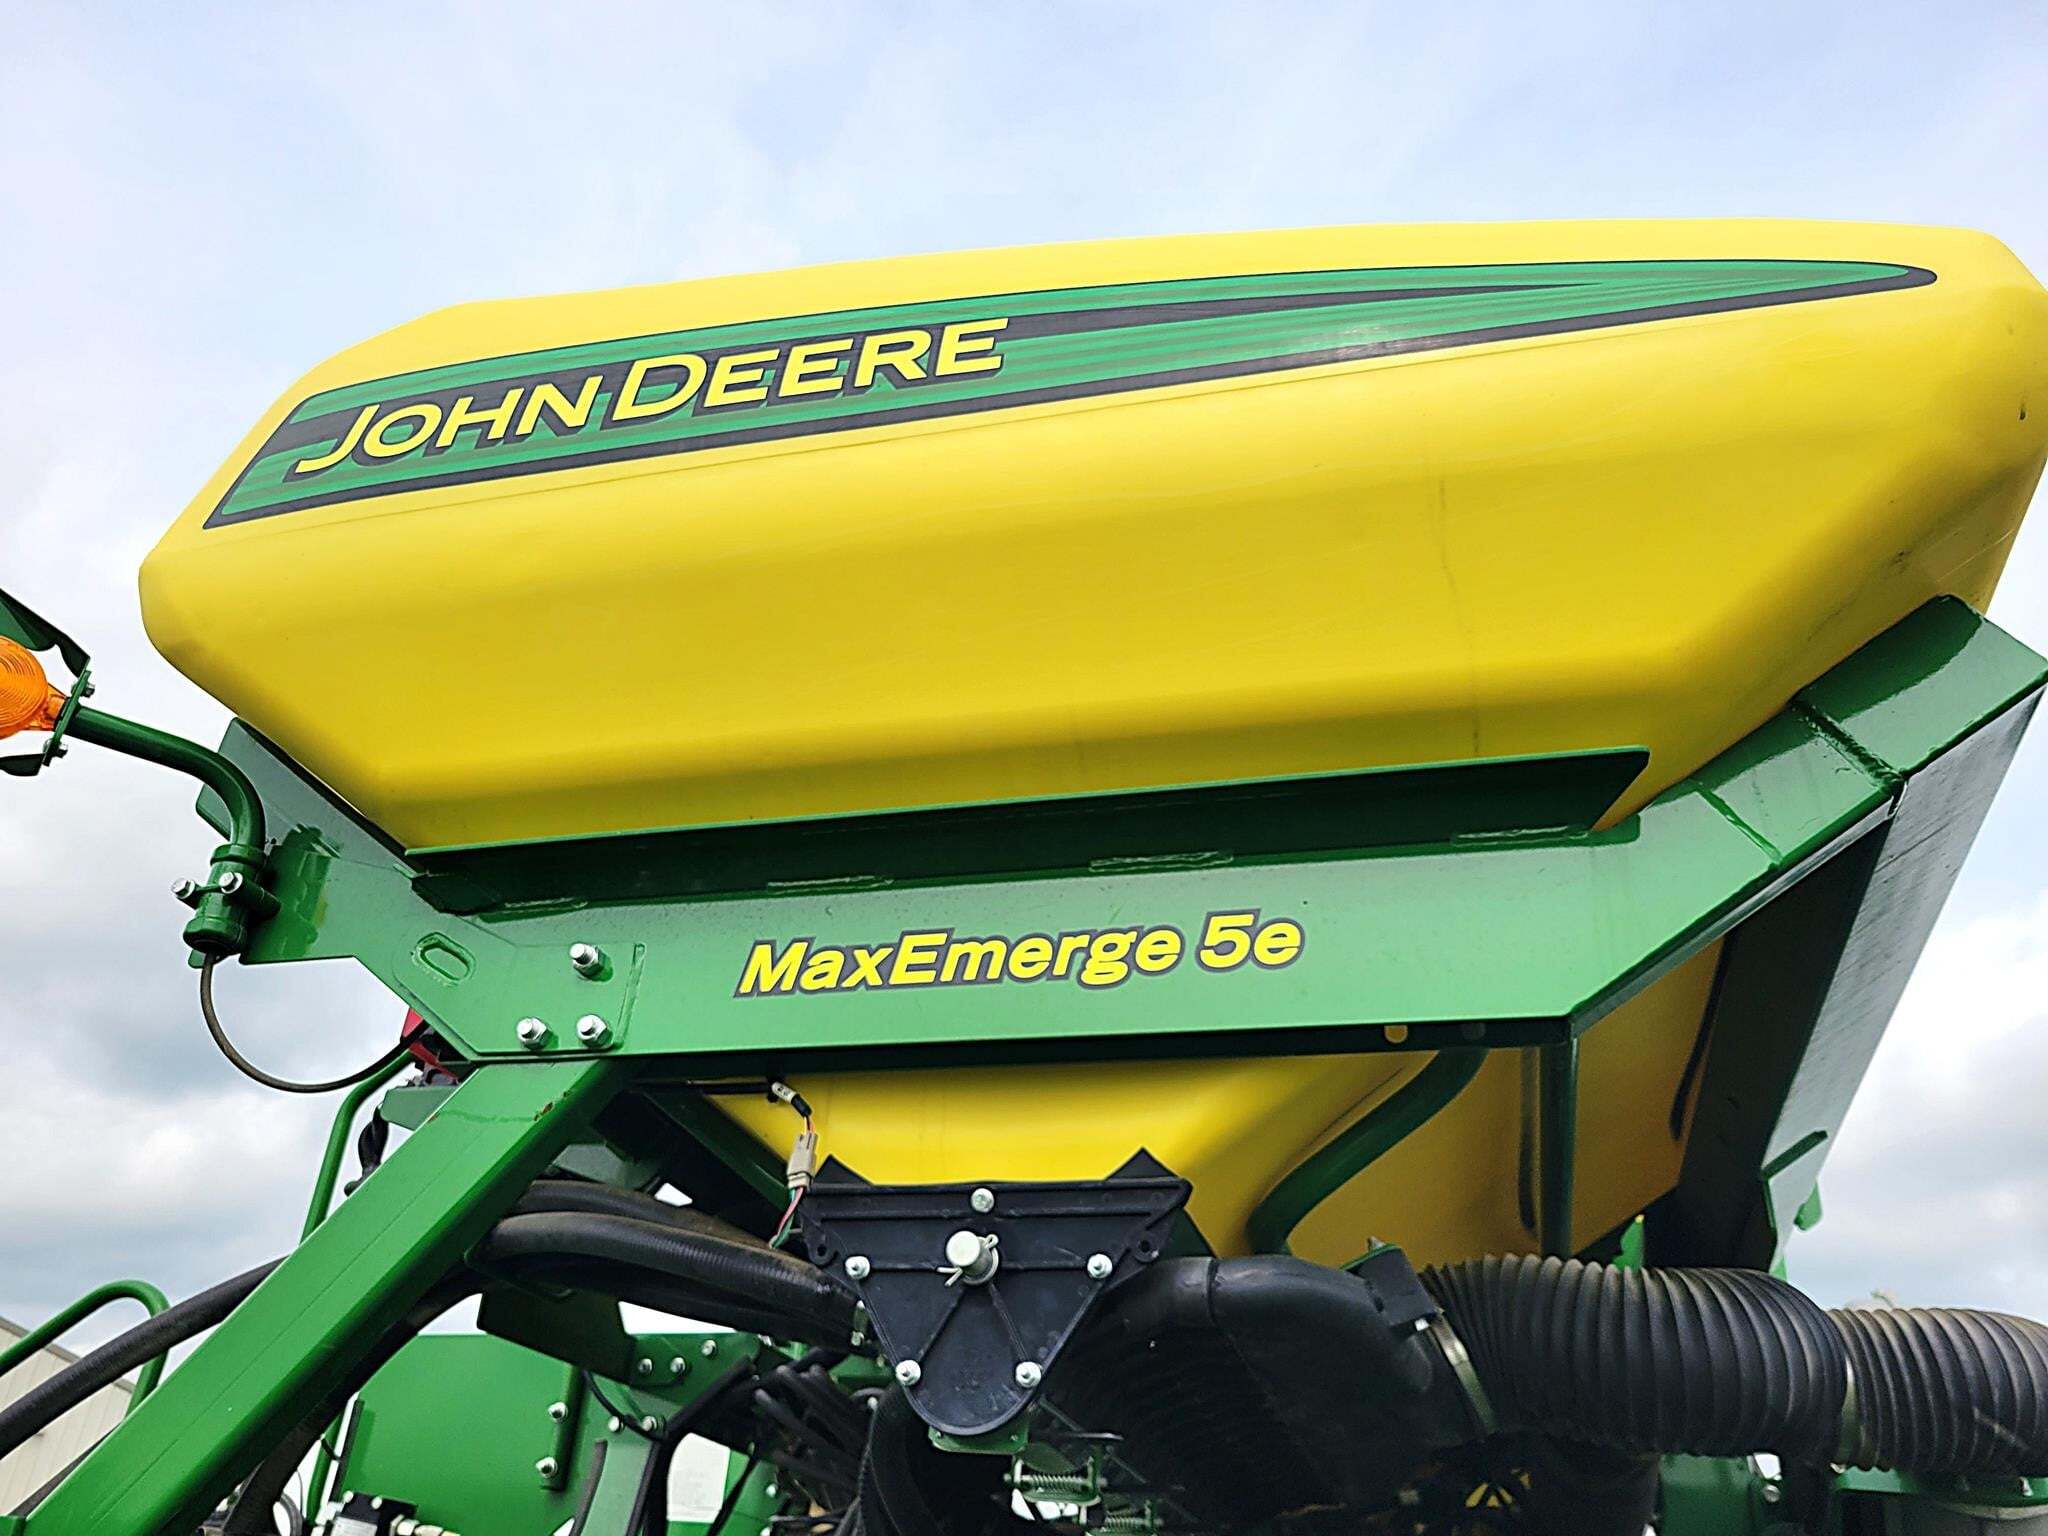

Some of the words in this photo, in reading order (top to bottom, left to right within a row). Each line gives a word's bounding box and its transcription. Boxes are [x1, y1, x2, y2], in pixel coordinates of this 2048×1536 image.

[296, 376, 601, 474] JOHN
[611, 317, 1009, 421] DEERE
[738, 927, 1183, 994] MaxEmerge
[1198, 913, 1302, 969] 5e
